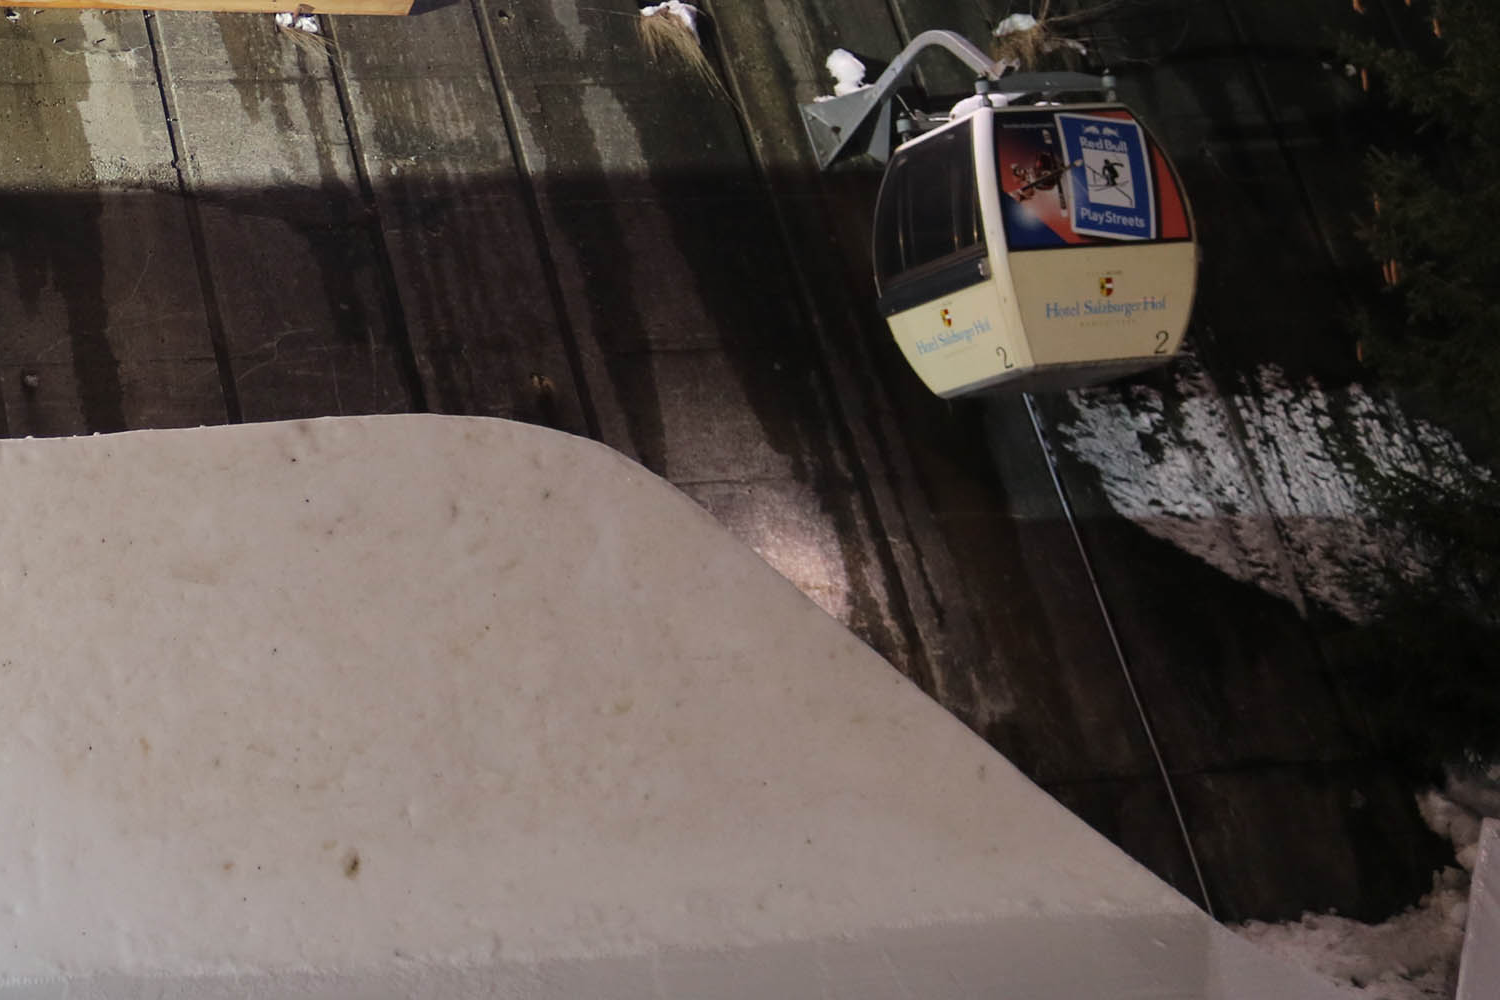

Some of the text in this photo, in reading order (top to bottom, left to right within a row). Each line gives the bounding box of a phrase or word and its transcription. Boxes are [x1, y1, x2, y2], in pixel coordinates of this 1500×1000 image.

[1079, 135, 1128, 153] Red Bull
[1045, 302, 1080, 319] Hotel
[1154, 330, 1169, 354] 2
[996, 346, 1014, 369] 2
